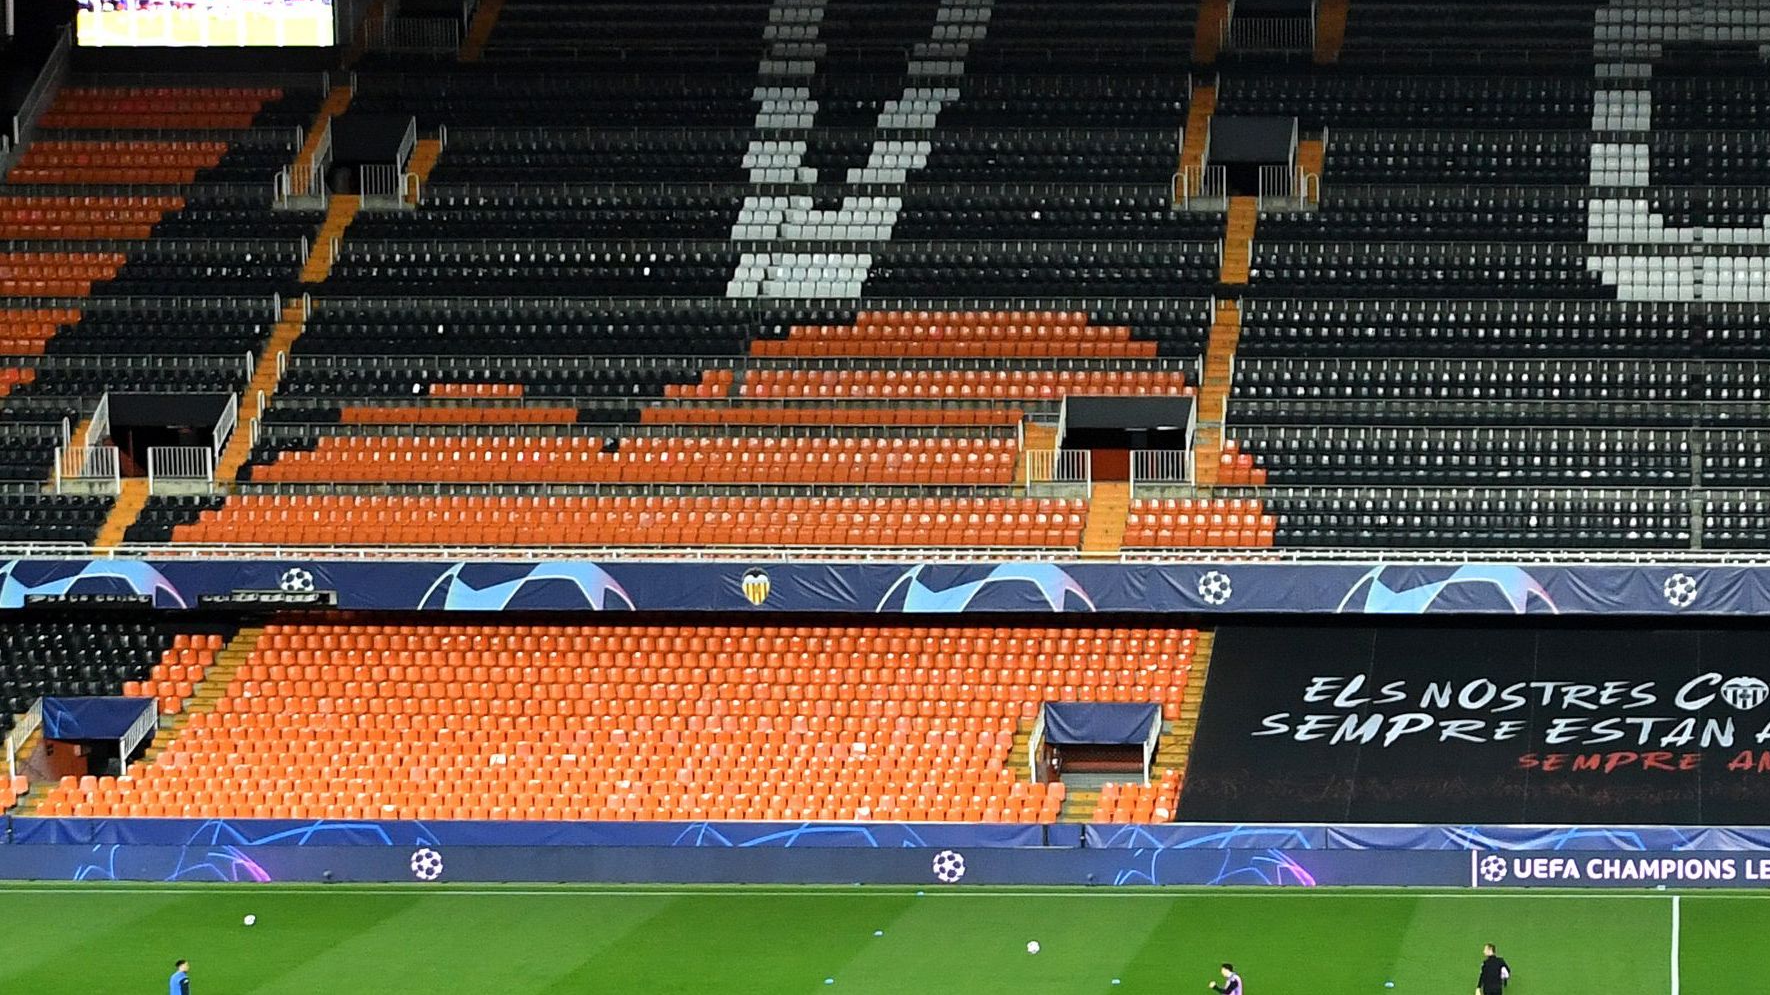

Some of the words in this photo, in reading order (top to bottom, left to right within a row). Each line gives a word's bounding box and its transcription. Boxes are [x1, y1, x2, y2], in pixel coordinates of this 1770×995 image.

[1304, 675, 1407, 708] ELS
[1420, 678, 1657, 712] NOSTRES
[1252, 712, 1527, 747] SEMPRE
[1545, 717, 1735, 748] ESTAN
[1518, 751, 1700, 773] SEMPRE
[1514, 858, 1581, 879] UEFA
[1586, 858, 1737, 880] CHAMPIONS
